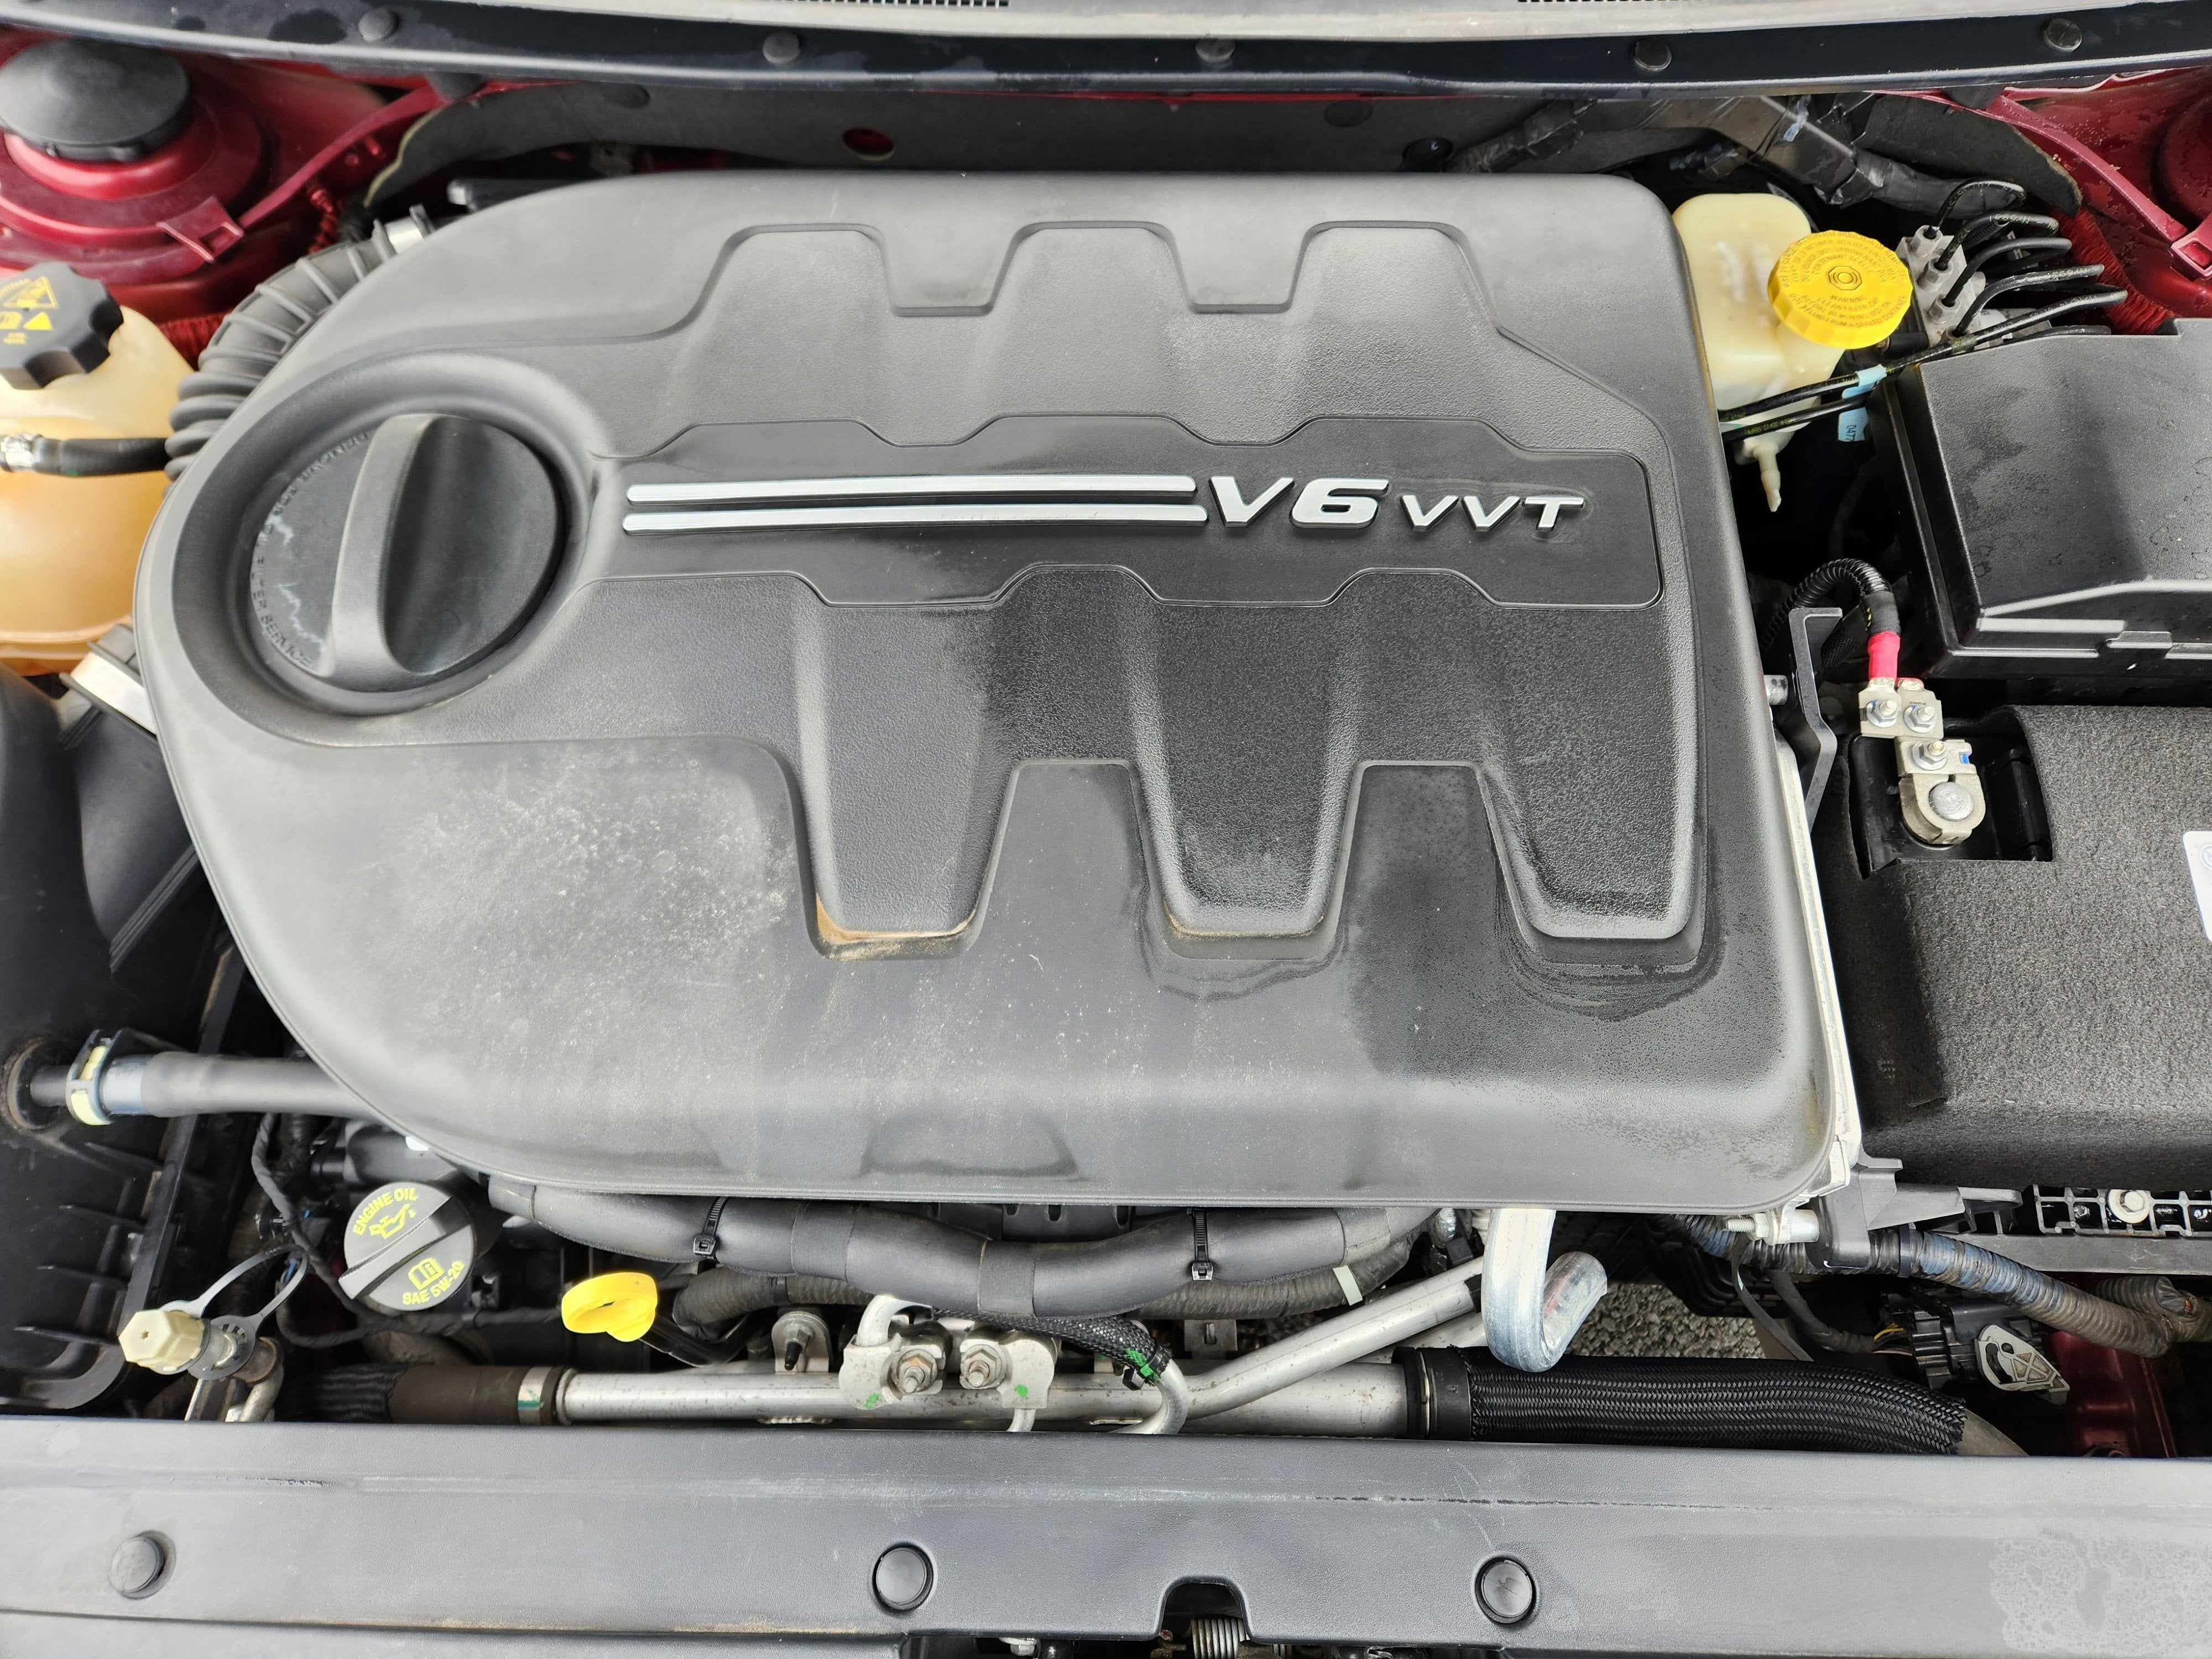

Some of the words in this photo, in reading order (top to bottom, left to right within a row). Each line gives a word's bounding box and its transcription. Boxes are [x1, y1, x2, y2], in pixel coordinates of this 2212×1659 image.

[1210, 476, 1390, 529] V6
[1401, 494, 1584, 531] VVT
[260, 613, 313, 667] SERVICE
[352, 1192, 394, 1236] ENGINE
[394, 1187, 419, 1202] OIL
[403, 1290, 431, 1306] SAE
[430, 1260, 466, 1298] 5W-20
